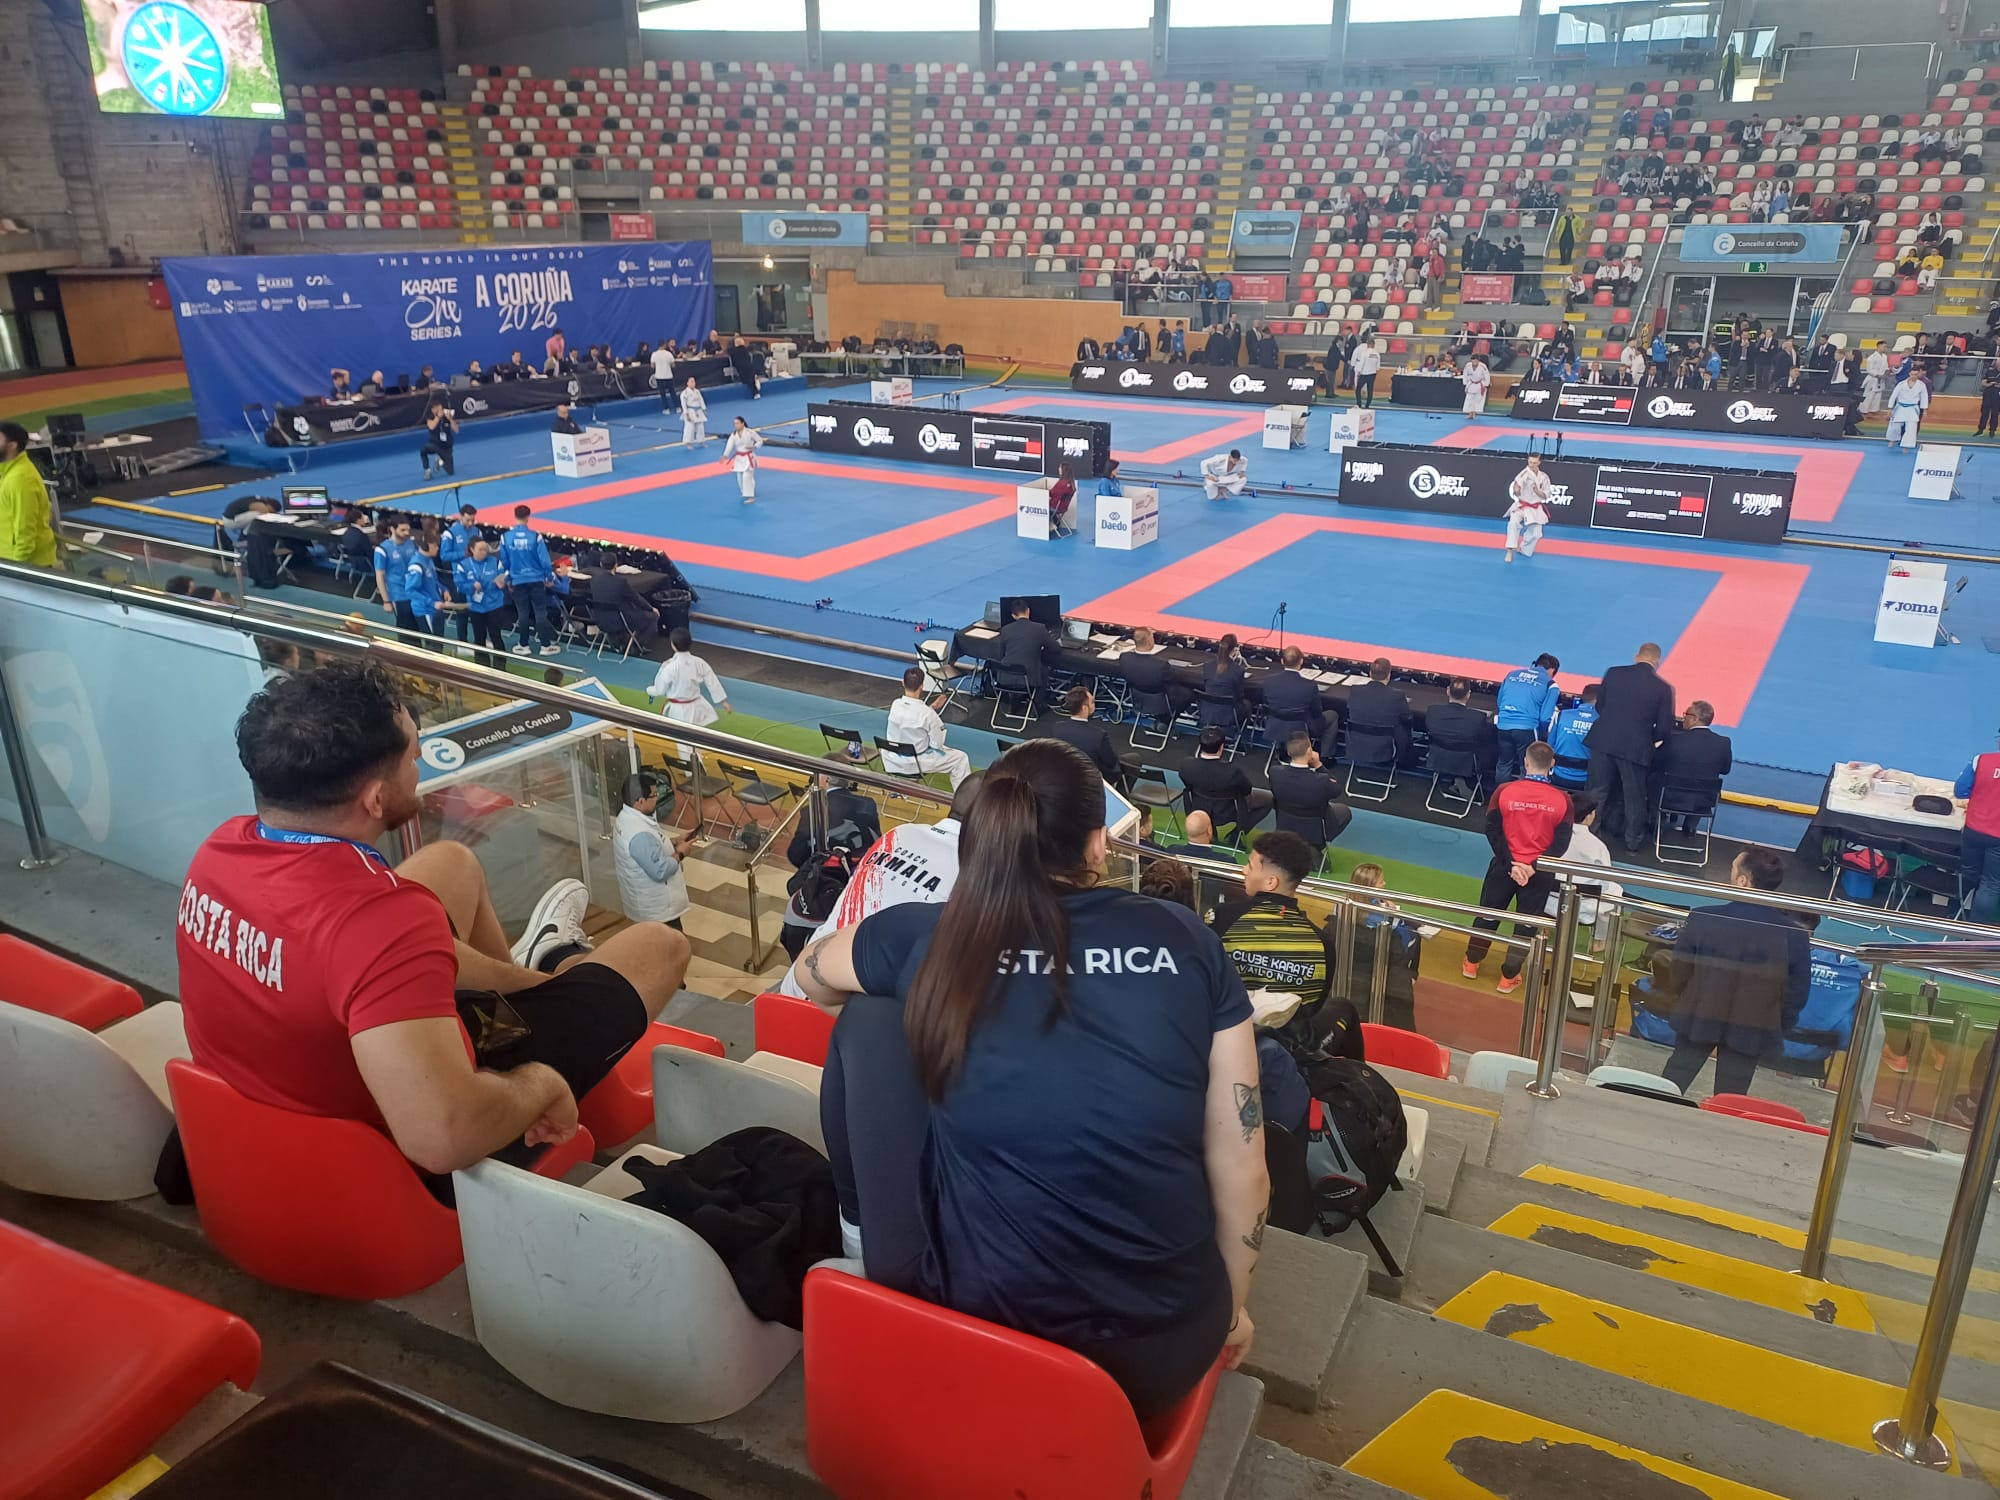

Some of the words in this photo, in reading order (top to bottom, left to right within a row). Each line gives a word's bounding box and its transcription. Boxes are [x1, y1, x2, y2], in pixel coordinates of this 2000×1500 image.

[379, 257, 408, 266] THE
[422, 255, 475, 265] WORLD
[486, 253, 500, 262] IS
[511, 252, 538, 261] OUR
[549, 250, 584, 260] DOJO
[402, 277, 458, 296] KARATE
[475, 274, 491, 308] A
[495, 266, 573, 307] CORUÑA
[405, 295, 462, 328] One
[499, 302, 558, 334] 2026
[411, 326, 452, 341] SERIES
[452, 325, 462, 337] A
[1345, 461, 1351, 473] A
[1441, 476, 1465, 486] BEST
[1438, 486, 1470, 497] SPORT
[1550, 485, 1568, 496] EST
[1541, 494, 1574, 506] PORT
[1732, 492, 1740, 505] A
[1742, 493, 1783, 509] CORUÑA
[1101, 519, 1127, 532] Daedo
[465, 730, 510, 749] Concello
[511, 722, 525, 735] da
[525, 711, 561, 729] Coruña
[894, 847, 928, 865] COACH
[866, 851, 942, 893] CKMAIA
[178, 878, 233, 960] COSTA
[235, 918, 283, 993] RICA
[1084, 946, 1179, 975] RICA
[1232, 950, 1269, 967] CLUBE
[1270, 957, 1315, 978] KARATÉ
[1240, 965, 1304, 986] VALONGO
[1811, 967, 1839, 980] TAFF
